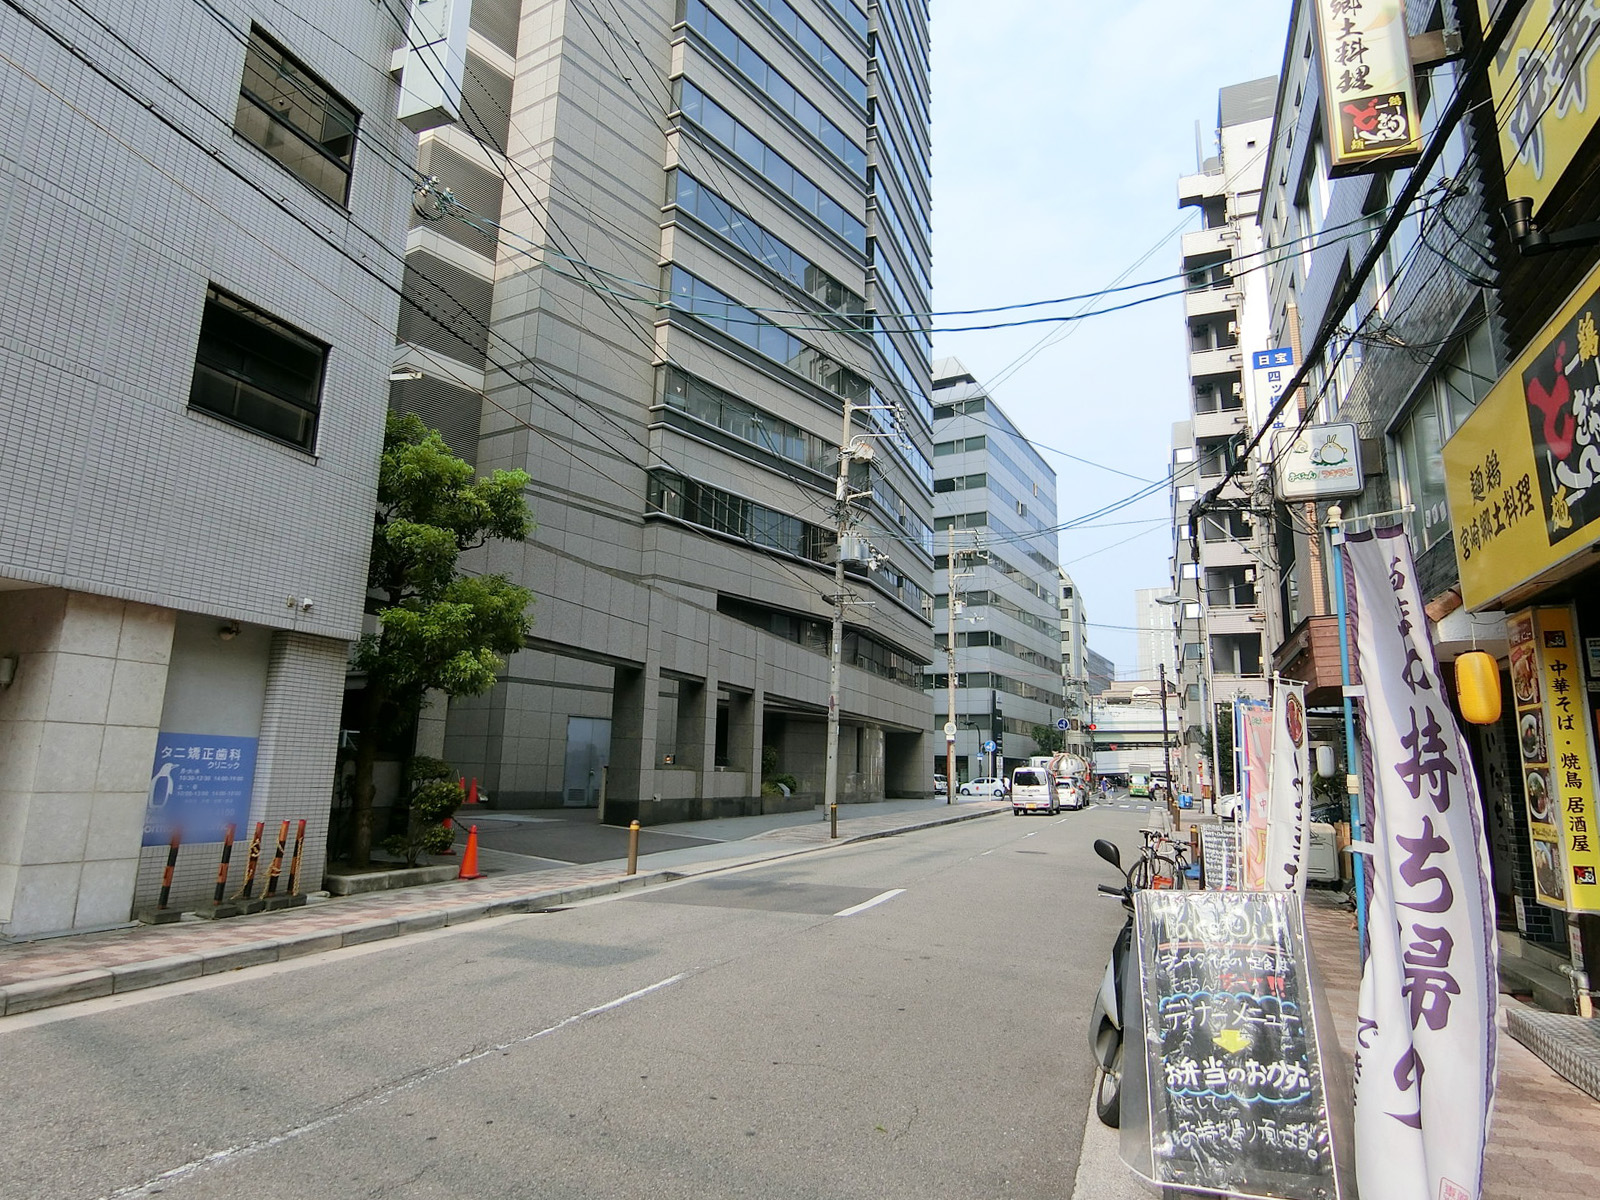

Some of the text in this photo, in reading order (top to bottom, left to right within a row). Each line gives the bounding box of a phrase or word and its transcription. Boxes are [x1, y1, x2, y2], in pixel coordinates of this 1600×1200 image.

[1330, 0, 1373, 94] 郷土料理
[1258, 352, 1288, 366] 日宝
[1459, 473, 1535, 561] 宮崎郷土料理
[161, 746, 242, 761] タニ矯正歯科
[207, 761, 240, 770] クリニック
[1164, 1055, 1311, 1091] お弁当のおかず
